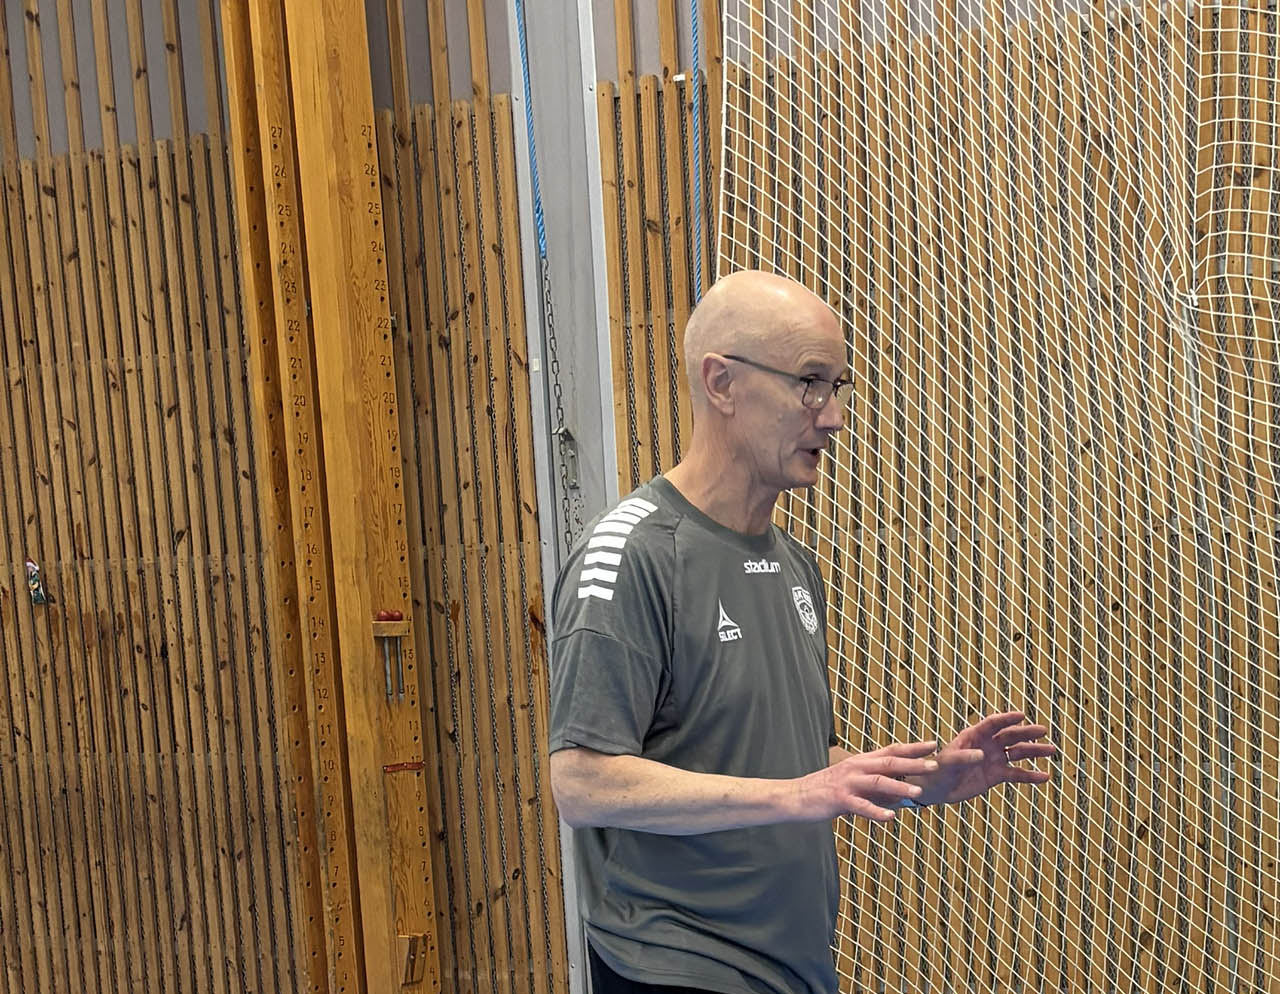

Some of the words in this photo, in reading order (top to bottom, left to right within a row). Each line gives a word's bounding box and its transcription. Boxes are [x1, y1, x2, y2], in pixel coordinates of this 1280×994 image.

[271, 126, 282, 138] 27
[361, 125, 372, 138] 27
[274, 165, 287, 178] 26
[364, 164, 377, 176] 26
[278, 204, 291, 216] 25
[368, 202, 381, 215] 25
[281, 242, 295, 255] 24
[371, 241, 384, 252] 24
[284, 281, 297, 294] 23
[374, 279, 386, 291] 23
[288, 320, 300, 332] 22
[377, 317, 390, 329] 22
[290, 357, 303, 369] 21
[380, 355, 392, 366] 21
[294, 395, 306, 406] 20
[383, 392, 395, 404] 20
[298, 432, 309, 444] 19
[387, 429, 398, 441] 19
[301, 470, 312, 481] 18
[390, 467, 400, 478] 18
[304, 507, 314, 518] 17
[393, 504, 402, 515] 17
[306, 543, 318, 555] 16
[395, 540, 406, 551] 16
[743, 559, 780, 573] stadium
[398, 576, 409, 588] 15
[312, 616, 324, 627] 14
[719, 628, 742, 642] SELECT
[315, 652, 326, 664] 13
[403, 649, 414, 660] 13
[317, 688, 328, 699] 12
[406, 684, 416, 695] 12
[320, 724, 331, 735] 11
[409, 720, 419, 731] 11
[323, 759, 334, 770] 10
